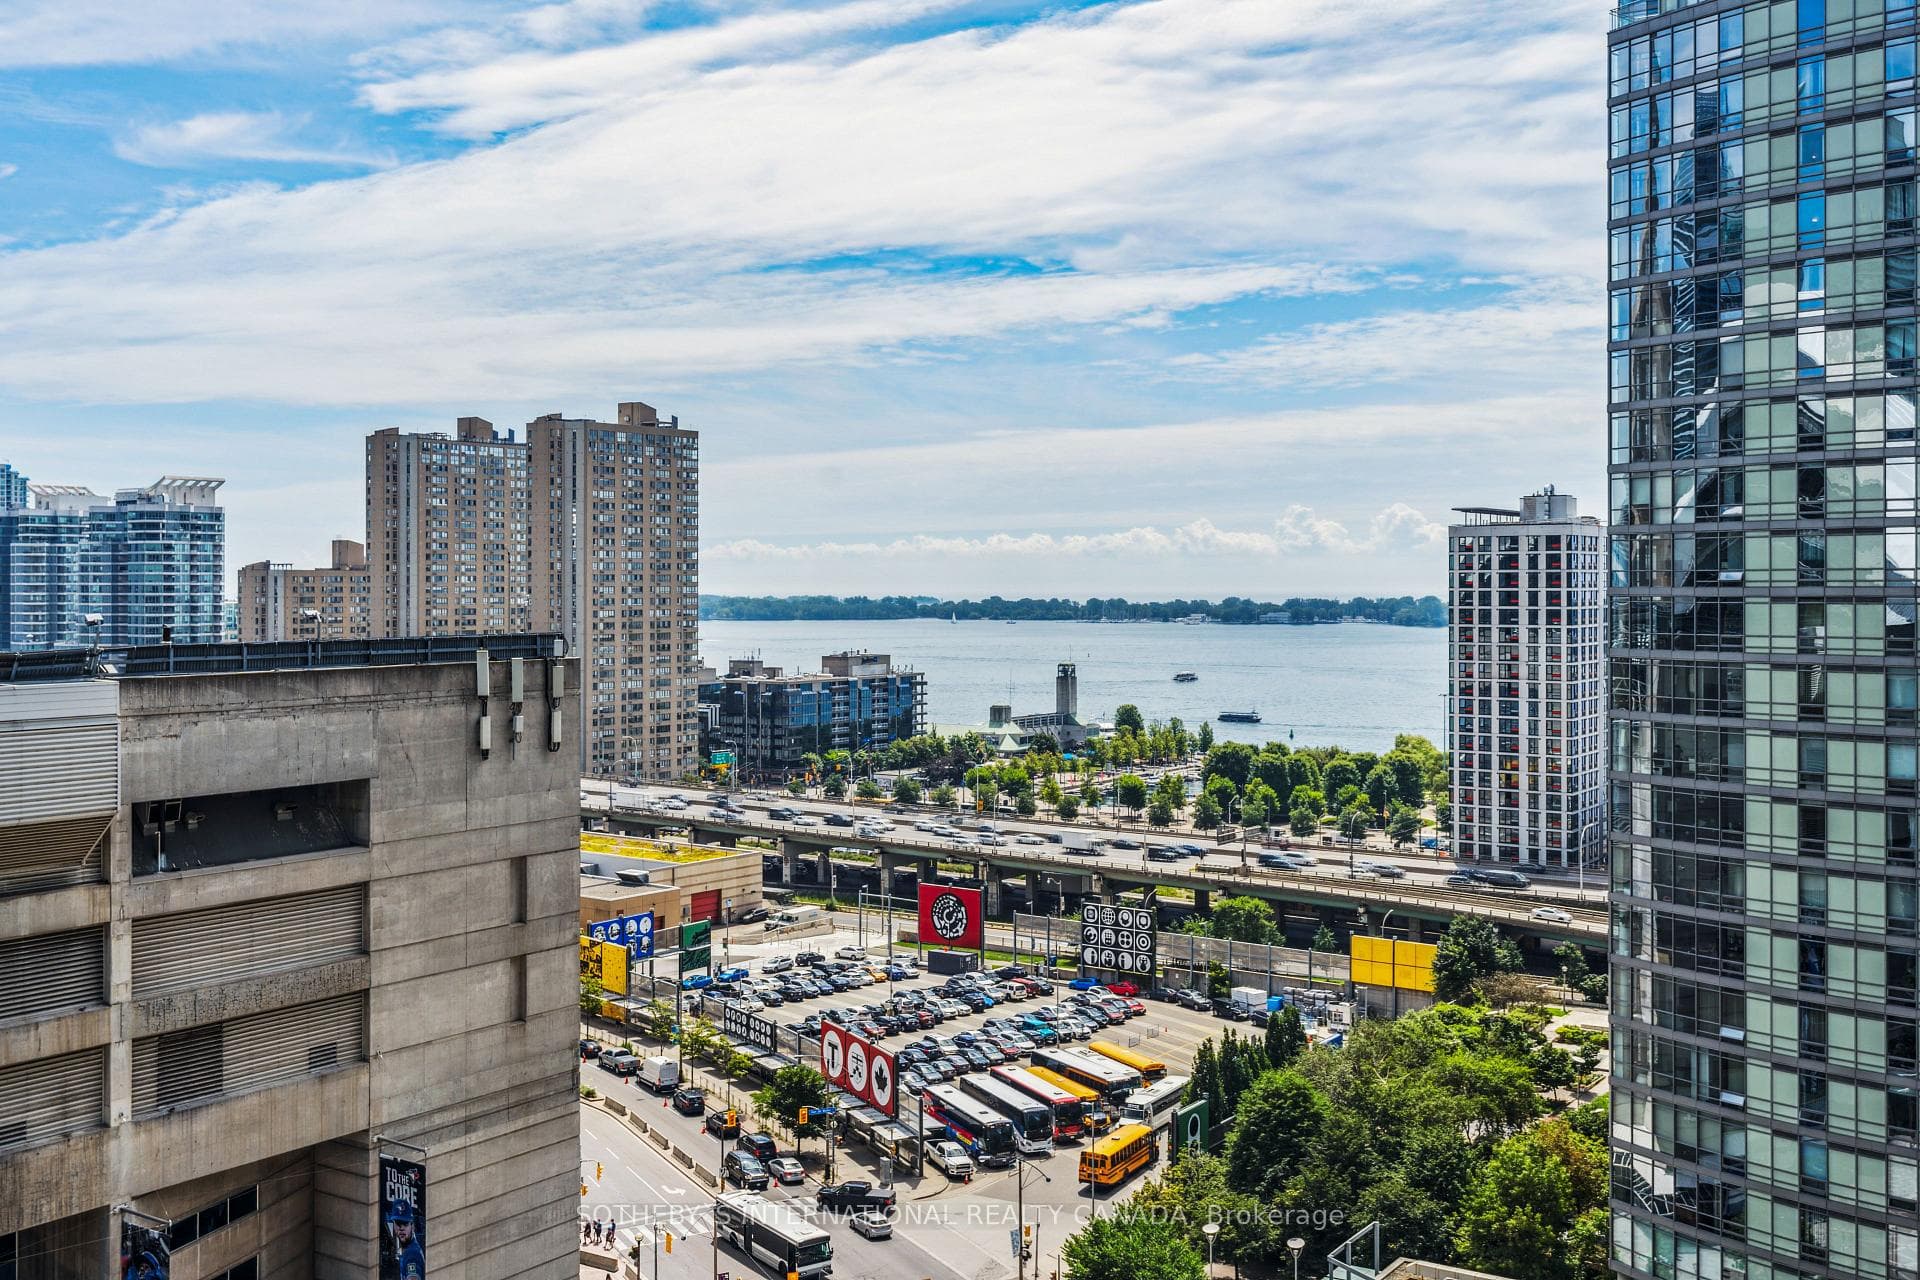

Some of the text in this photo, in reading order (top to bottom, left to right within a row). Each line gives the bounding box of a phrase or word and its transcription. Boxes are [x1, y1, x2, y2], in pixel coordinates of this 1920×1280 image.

[386, 1167, 410, 1186] TO THE
[386, 1182, 418, 1208] CORE
